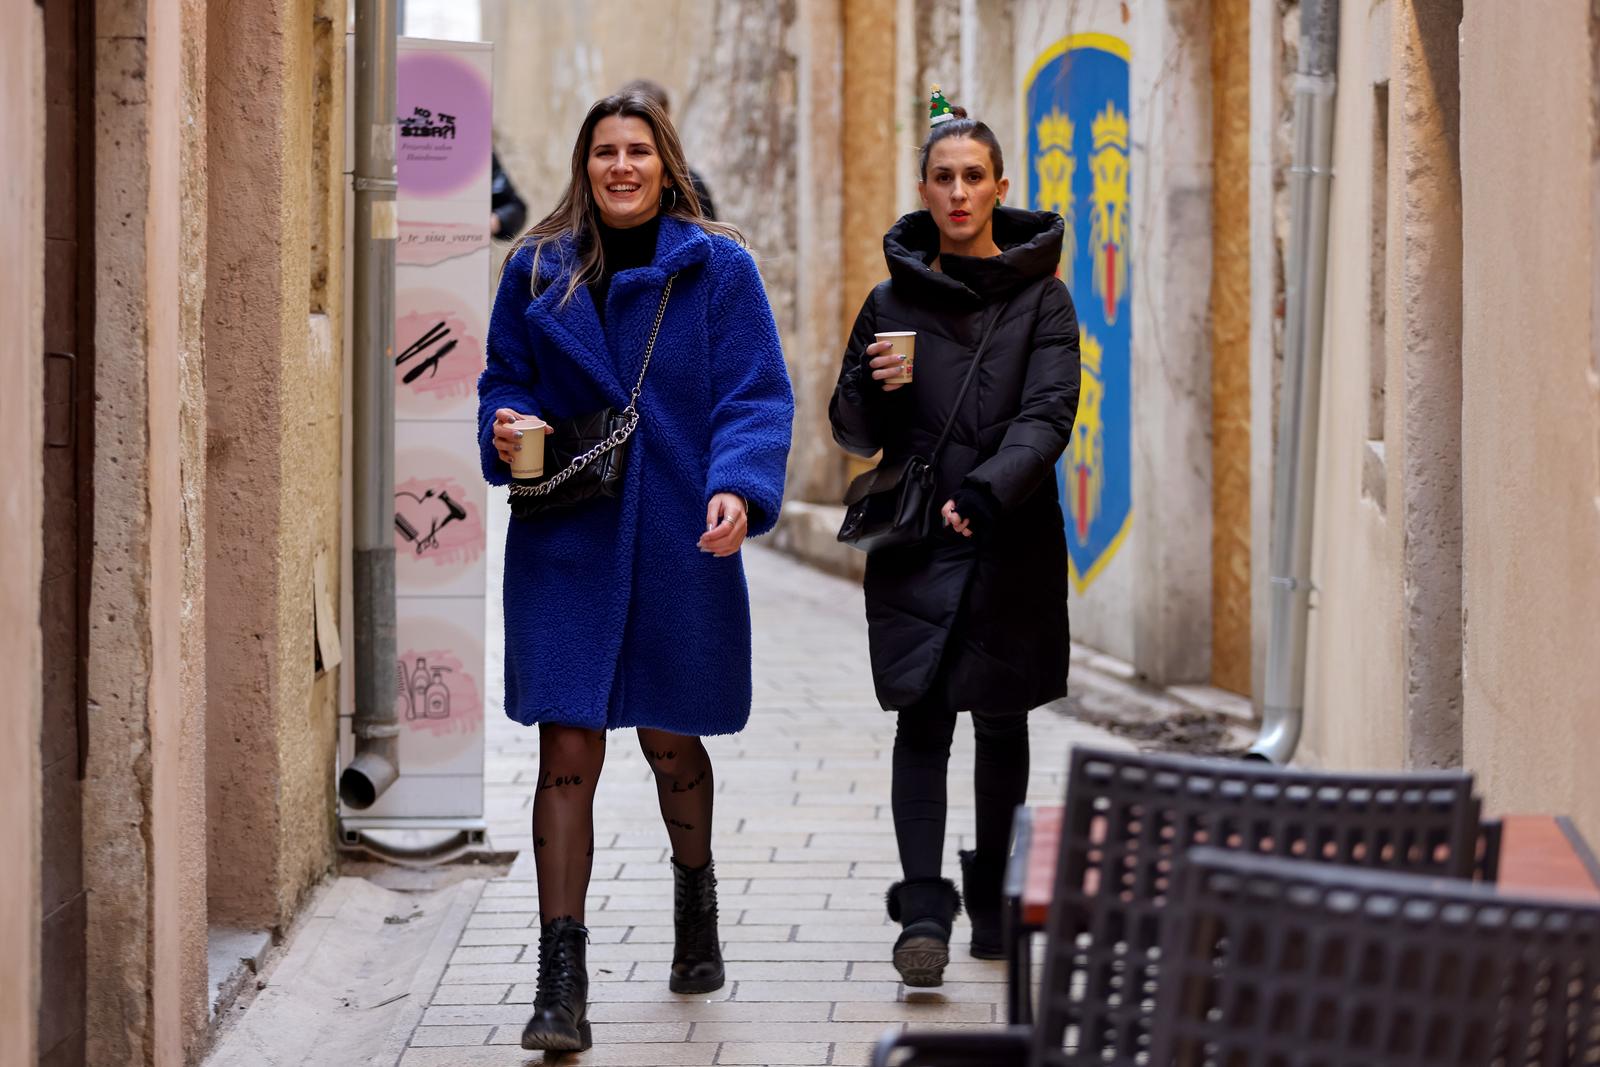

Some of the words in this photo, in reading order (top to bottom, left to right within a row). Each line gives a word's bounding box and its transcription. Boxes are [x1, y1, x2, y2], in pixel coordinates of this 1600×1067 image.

[414, 106, 432, 118] KO
[437, 112, 456, 125] TE
[541, 771, 583, 790] Love
